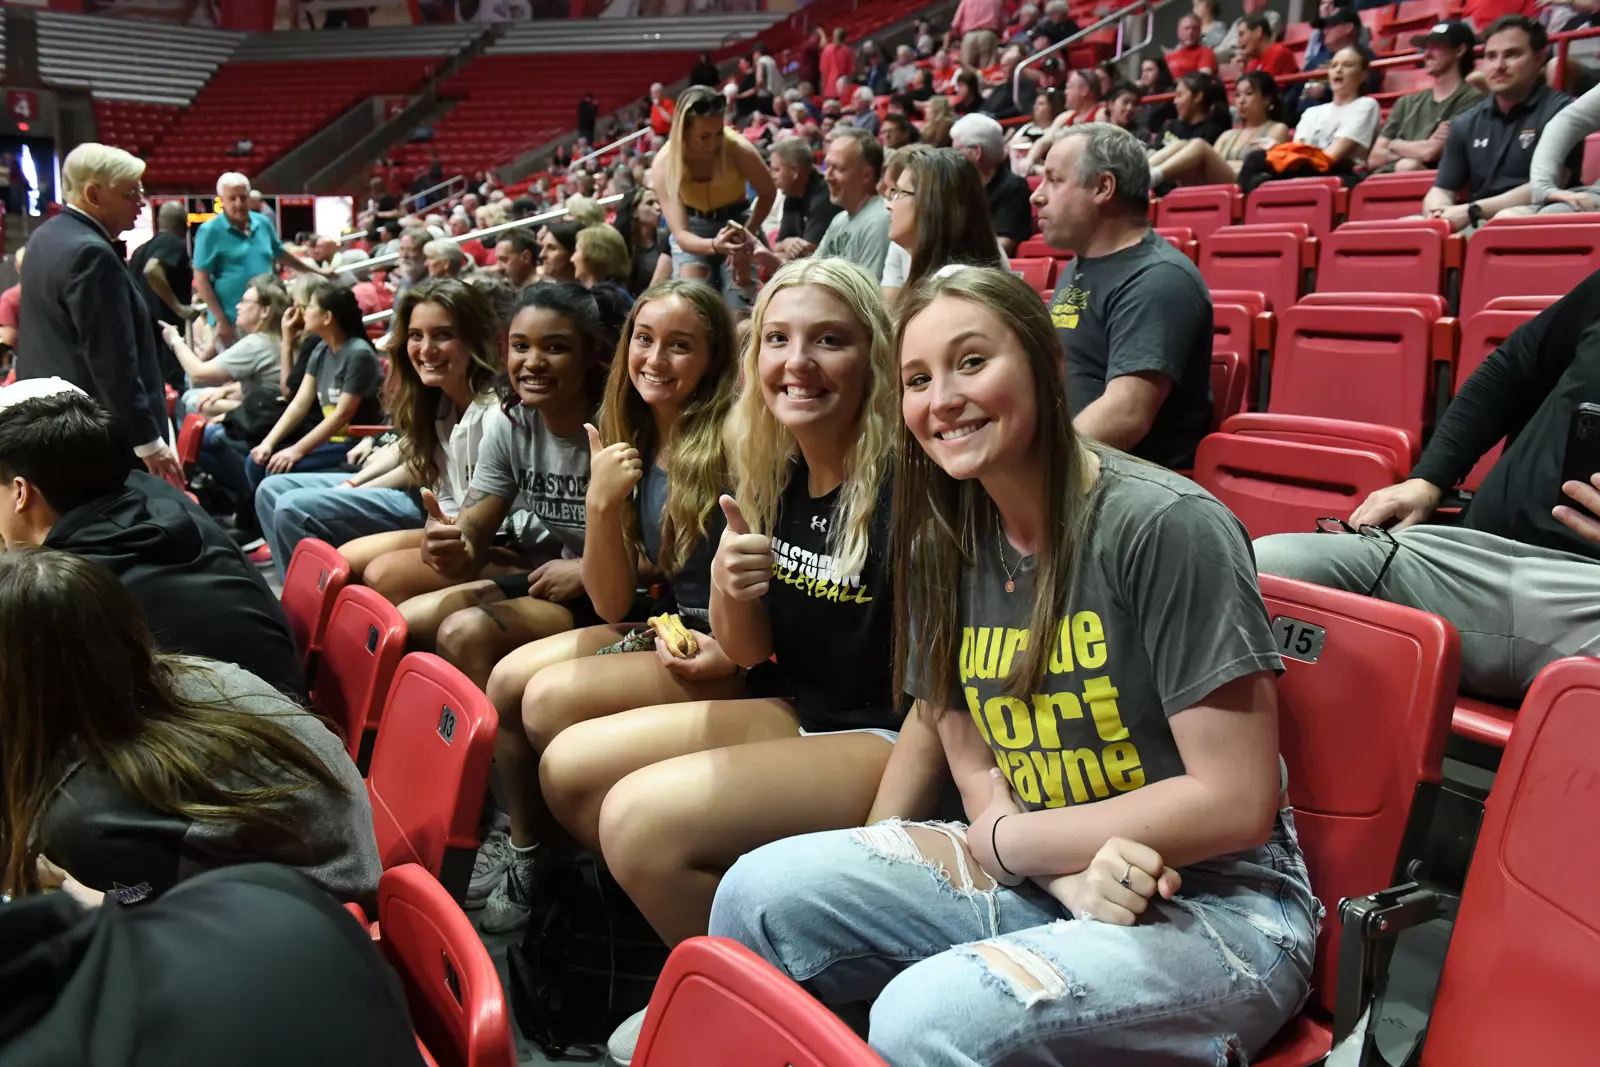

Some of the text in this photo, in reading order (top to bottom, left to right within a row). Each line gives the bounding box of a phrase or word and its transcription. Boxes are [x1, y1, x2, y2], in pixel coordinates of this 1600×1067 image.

[13, 98, 31, 118] 4
[518, 468, 588, 497] MASTOD
[532, 500, 587, 522] OLLEYB
[771, 562, 873, 604] OLLEYBALL
[959, 610, 1108, 684] purue
[1283, 623, 1316, 655] 15
[443, 712, 455, 738] 13
[964, 675, 1130, 749] fort
